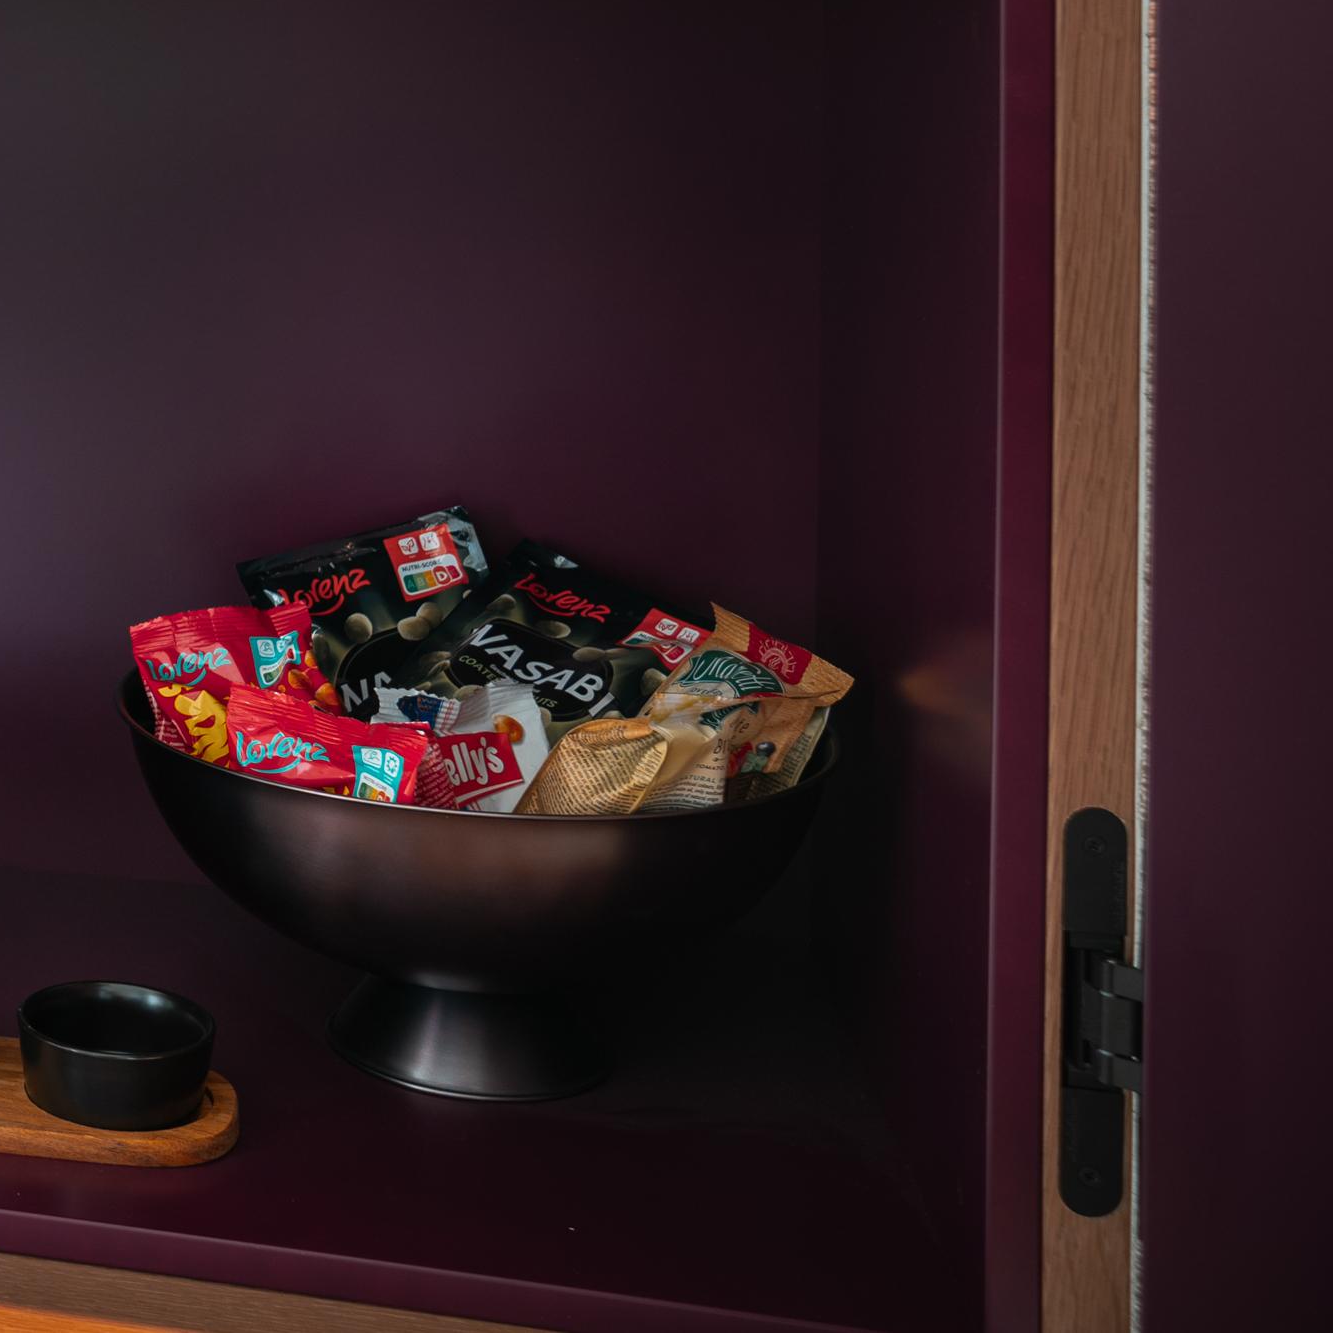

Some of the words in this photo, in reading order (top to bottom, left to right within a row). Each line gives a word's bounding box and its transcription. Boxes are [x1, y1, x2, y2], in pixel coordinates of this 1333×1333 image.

[278, 568, 371, 611] Lorenz
[514, 572, 612, 623] Lorenz
[146, 647, 232, 682] Lorenz
[458, 654, 501, 684] COATE
[235, 731, 330, 767] Lorenz
[443, 736, 504, 786] elly's
